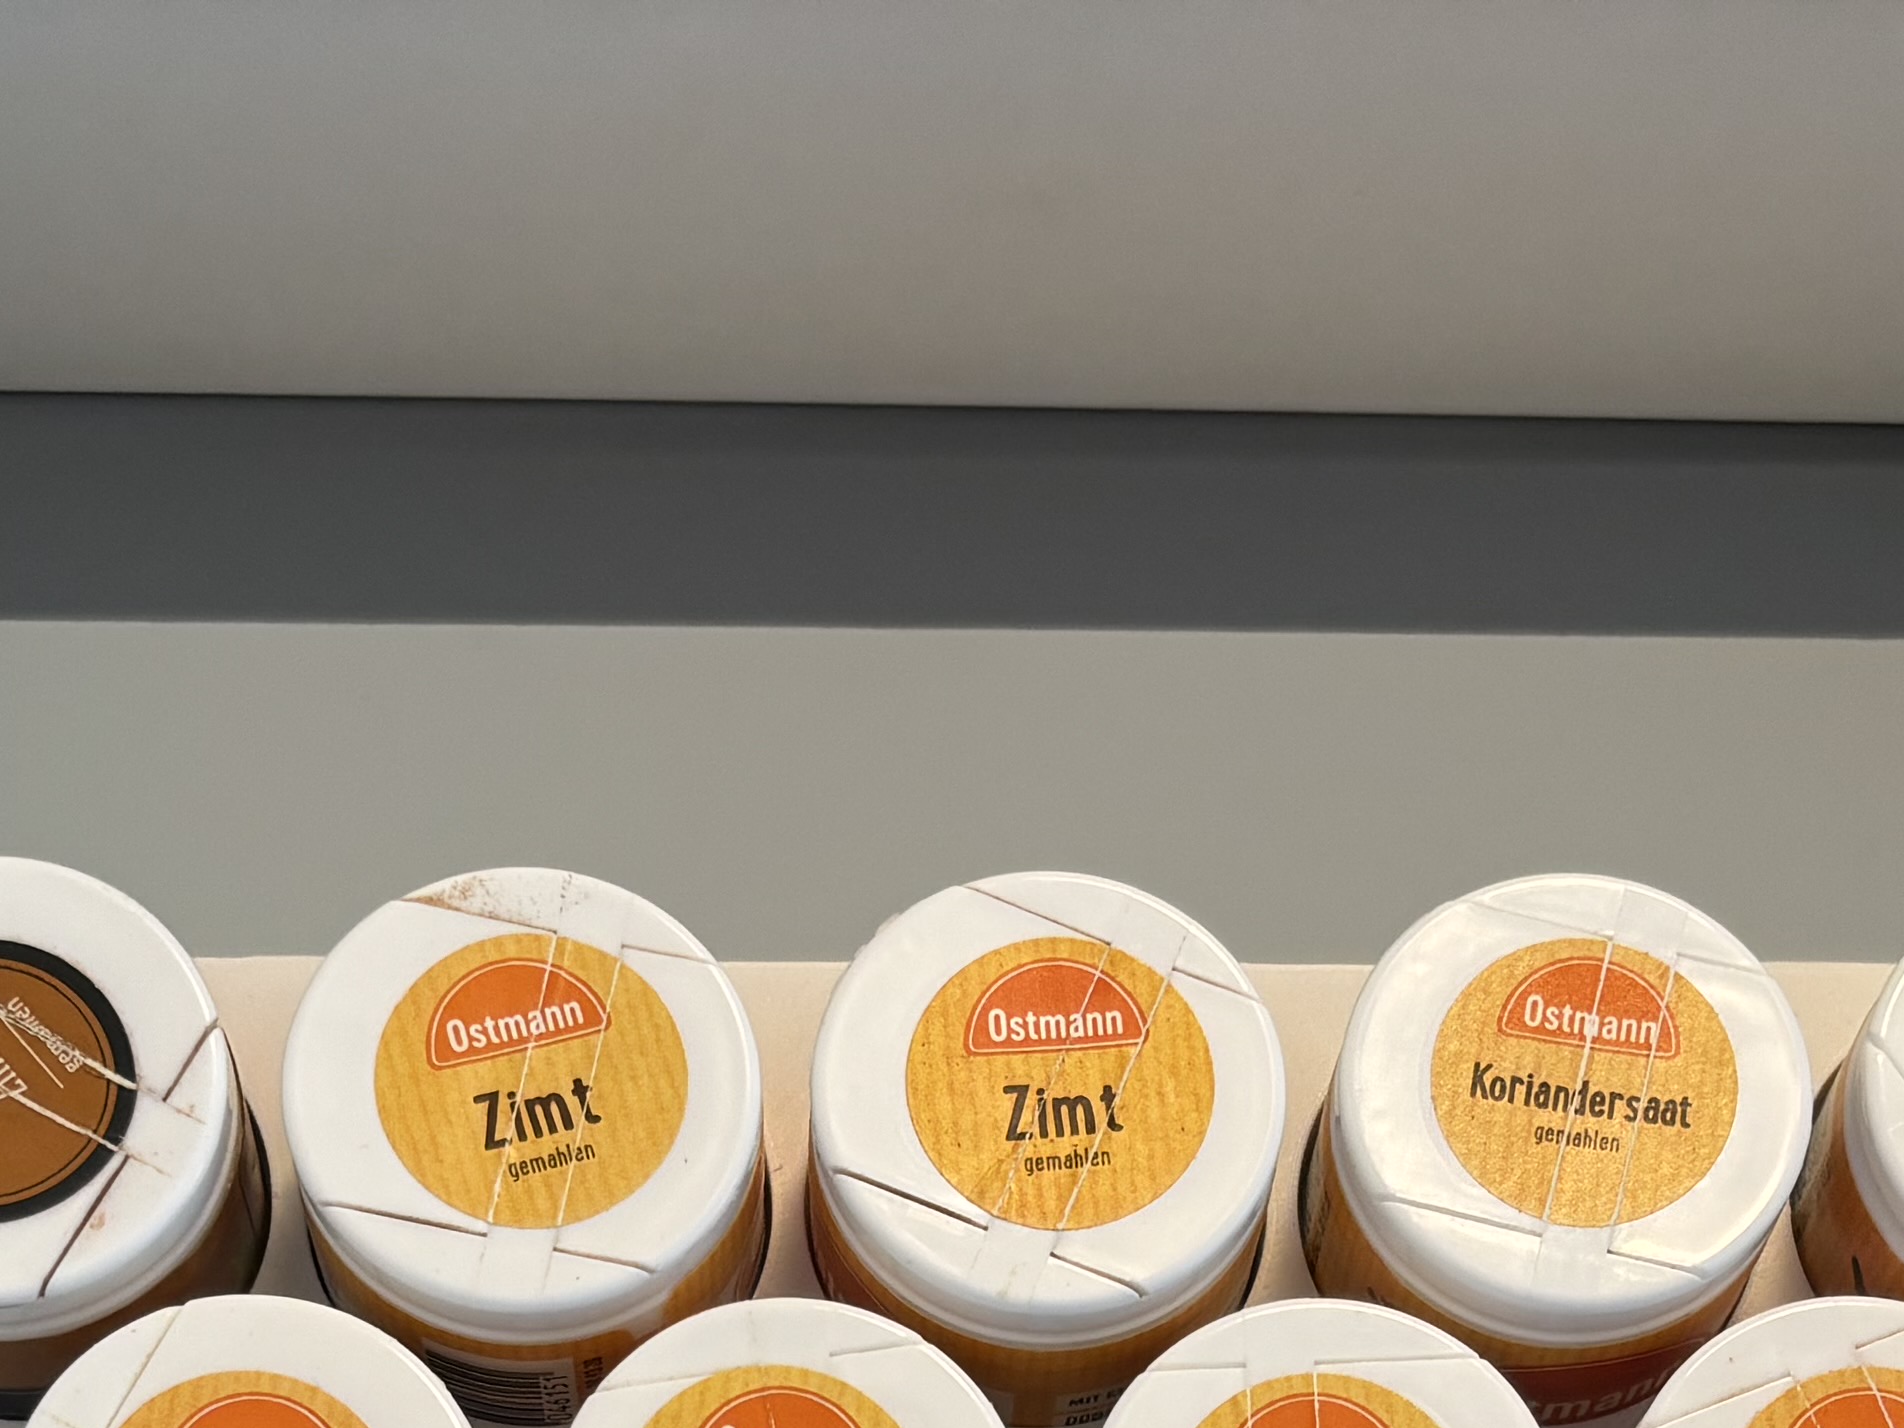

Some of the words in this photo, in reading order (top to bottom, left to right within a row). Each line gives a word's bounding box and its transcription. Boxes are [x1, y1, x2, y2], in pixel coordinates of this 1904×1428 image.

[446, 996, 584, 1054] Ostmann
[987, 1005, 1123, 1043] Ostmann
[1524, 995, 1657, 1045] Ostmann
[472, 1077, 602, 1152] Zimt
[1002, 1083, 1124, 1142] Zimt
[1469, 1062, 1692, 1131] Koriandersaat
[508, 1142, 597, 1182] gemahlen
[1024, 1146, 1111, 1177] gemahlen
[1534, 1124, 1621, 1154] gemahlen
